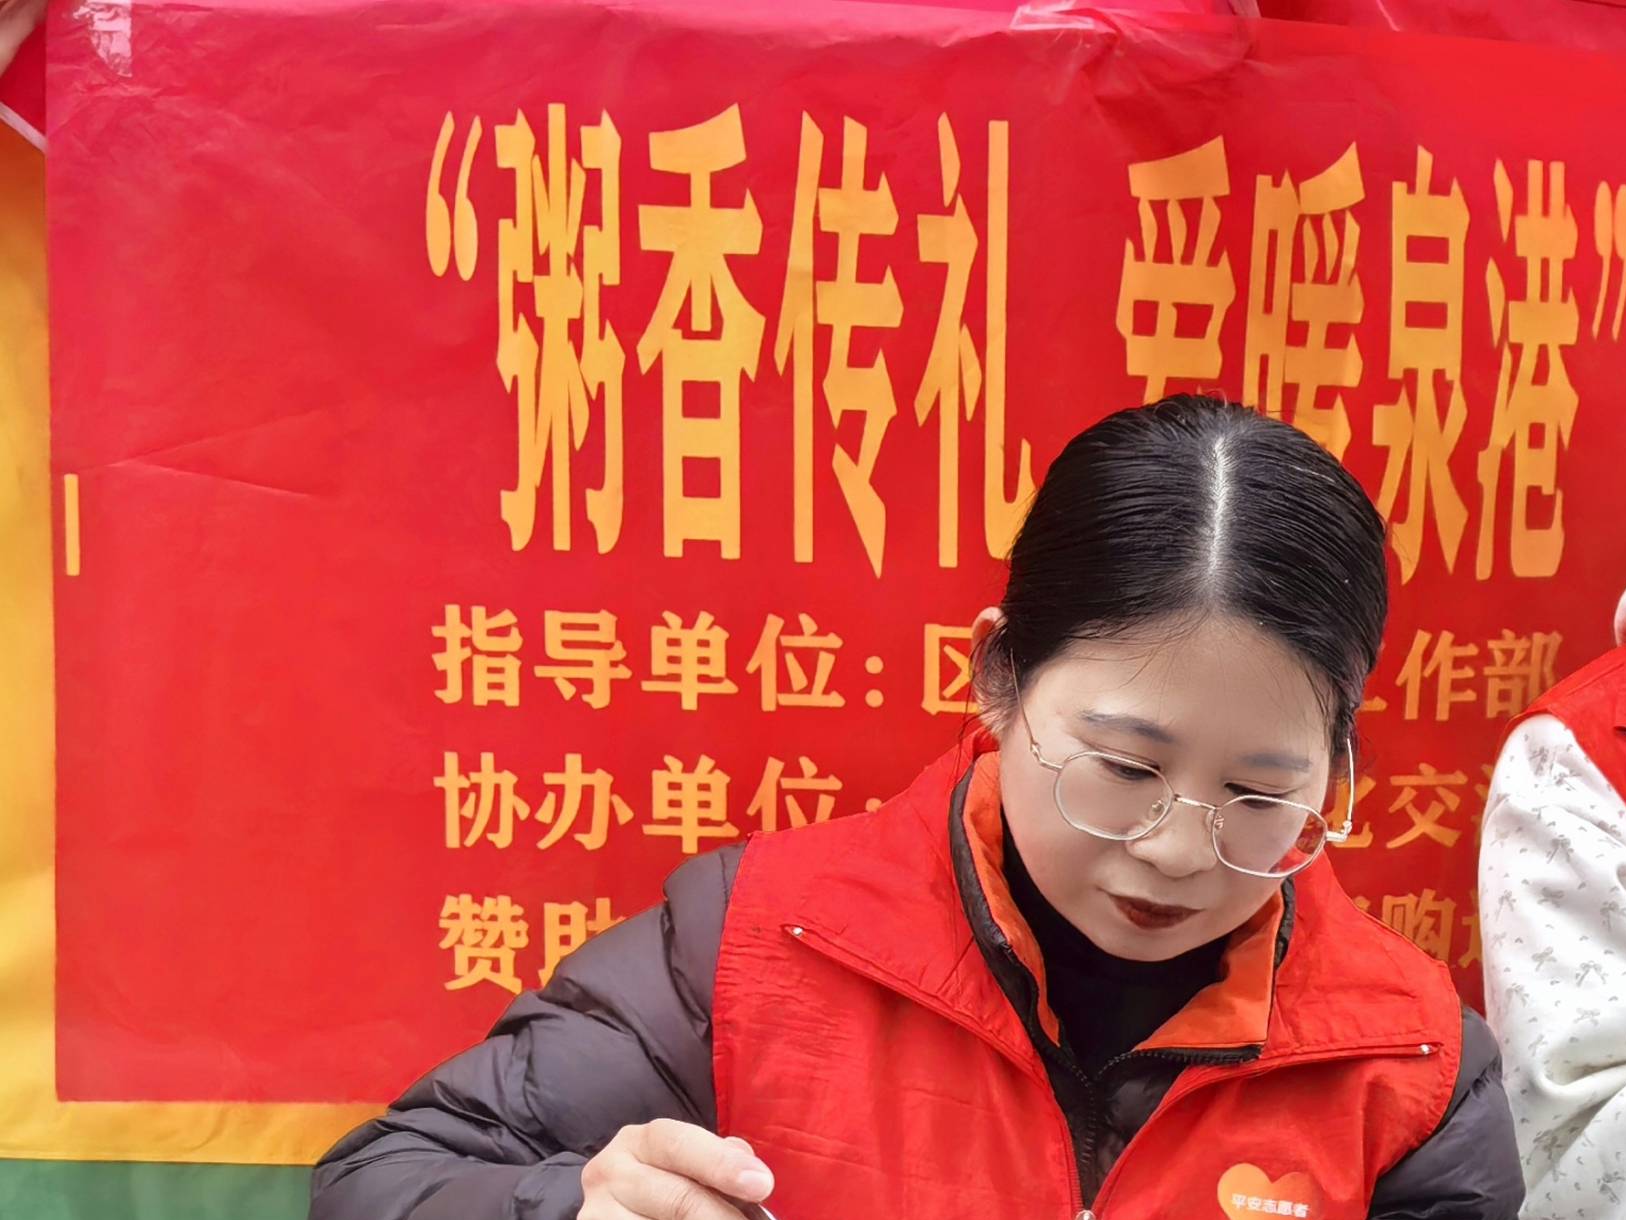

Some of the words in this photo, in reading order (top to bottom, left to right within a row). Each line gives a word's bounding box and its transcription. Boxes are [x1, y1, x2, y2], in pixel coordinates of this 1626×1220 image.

[434, 751, 882, 853] 协办单位
[1231, 1193, 1311, 1218] 平安志愿者
